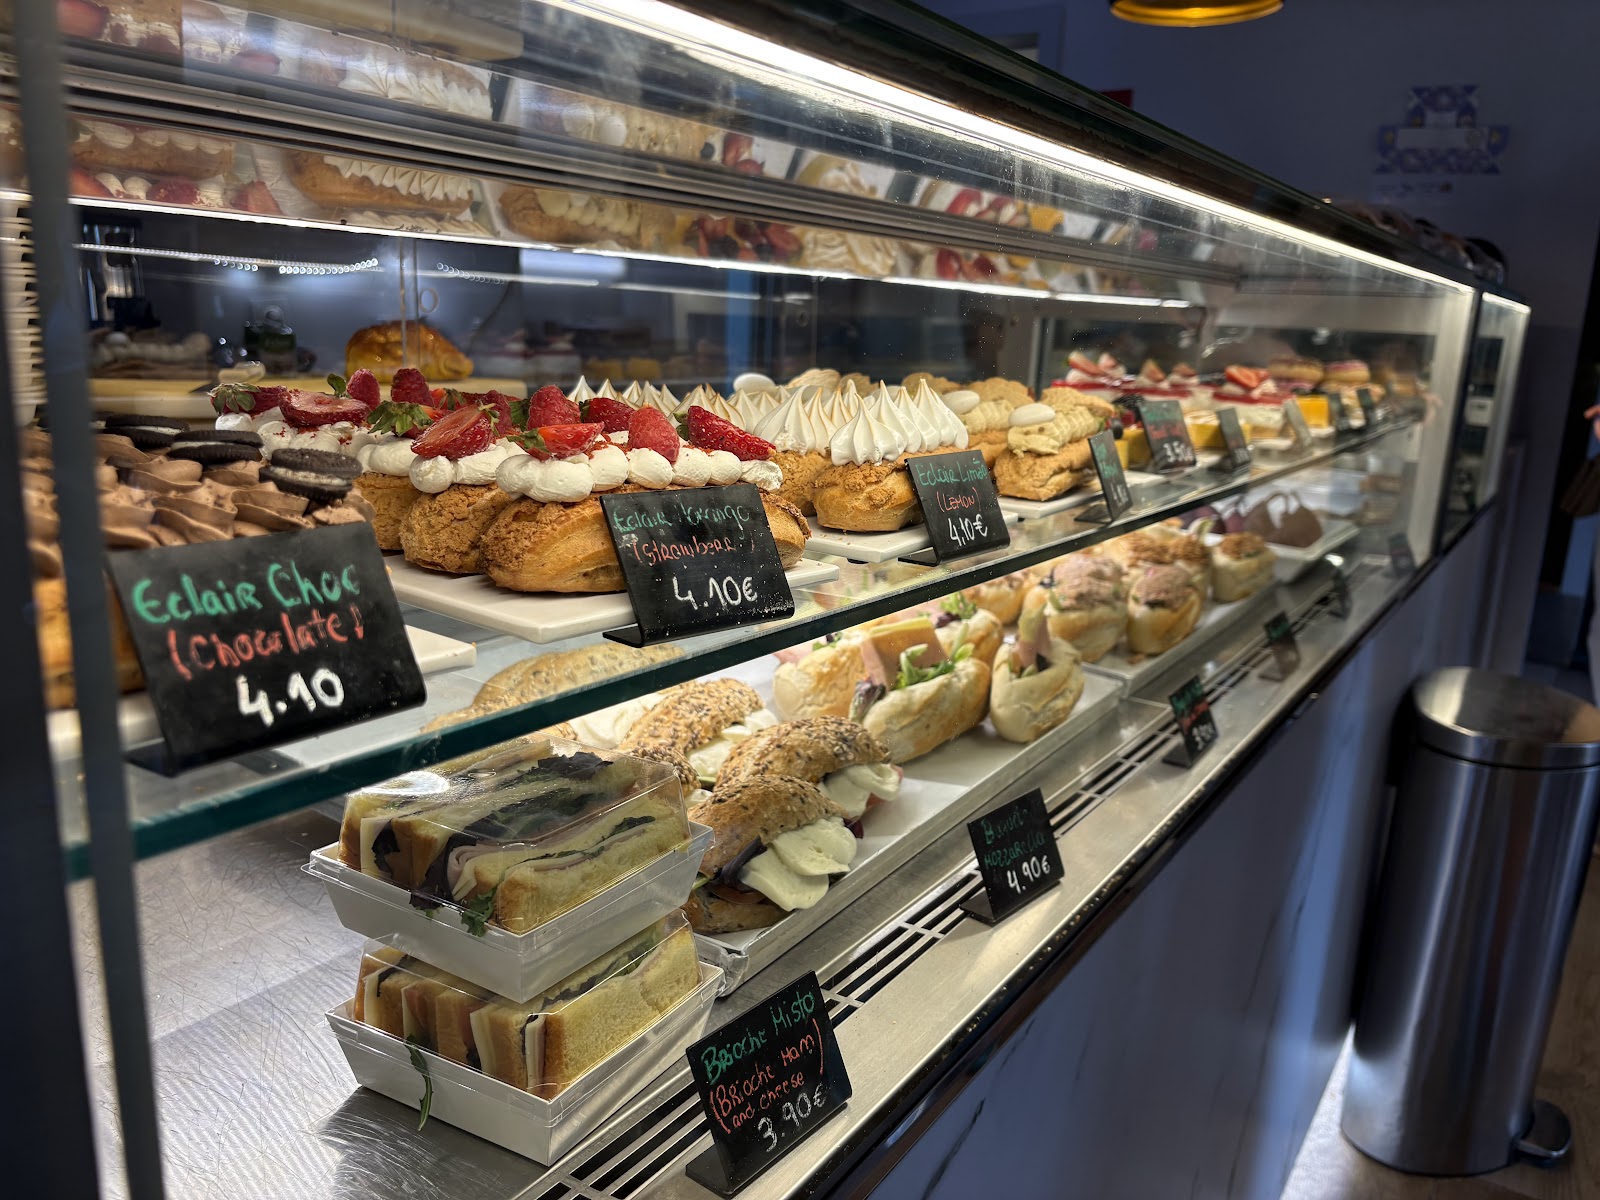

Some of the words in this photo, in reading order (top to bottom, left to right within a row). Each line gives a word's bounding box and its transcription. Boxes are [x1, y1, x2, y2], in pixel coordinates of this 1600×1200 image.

[672, 575, 758, 611] 4.10€
[235, 668, 345, 727] 4.10
[1006, 855, 1051, 894] 4.90€
[769, 991, 816, 1036] Misto
[732, 1105, 755, 1128] and
[757, 1078, 828, 1153] 3.90€
